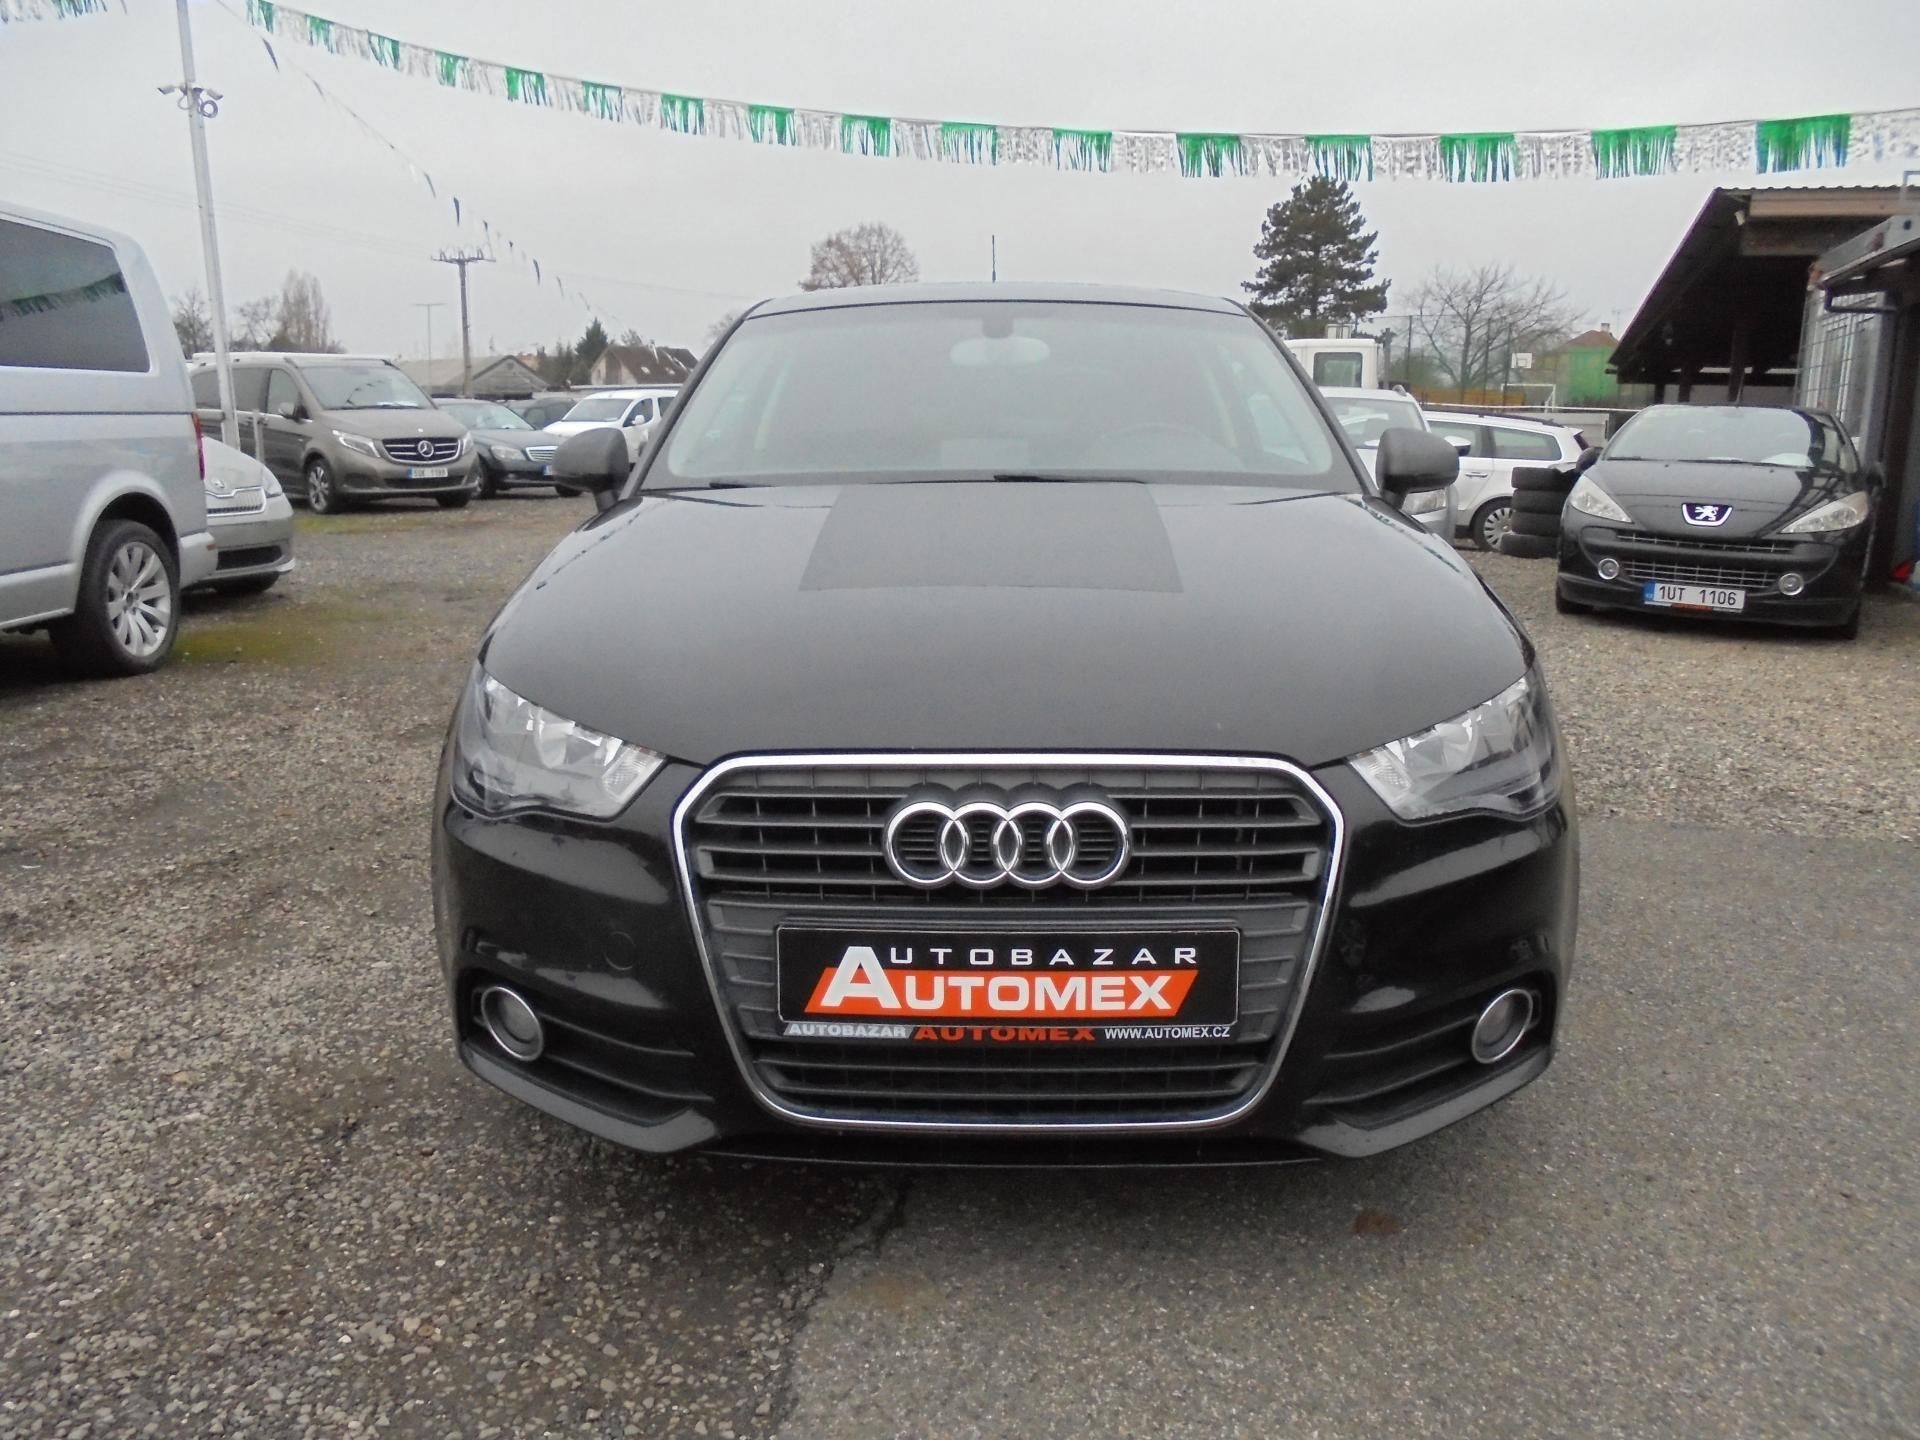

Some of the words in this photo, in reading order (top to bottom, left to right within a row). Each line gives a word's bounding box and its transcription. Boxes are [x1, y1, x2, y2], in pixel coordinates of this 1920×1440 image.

[1659, 585, 1686, 600] 1UT
[1699, 589, 1737, 606] 1106
[820, 946, 1172, 1010] AUTOMEX
[788, 1024, 906, 1037] AUTOBAZAR
[914, 1026, 1096, 1041] AUTOMEX
[1104, 1026, 1230, 1039] WWW.AUTOMEX.CZ
